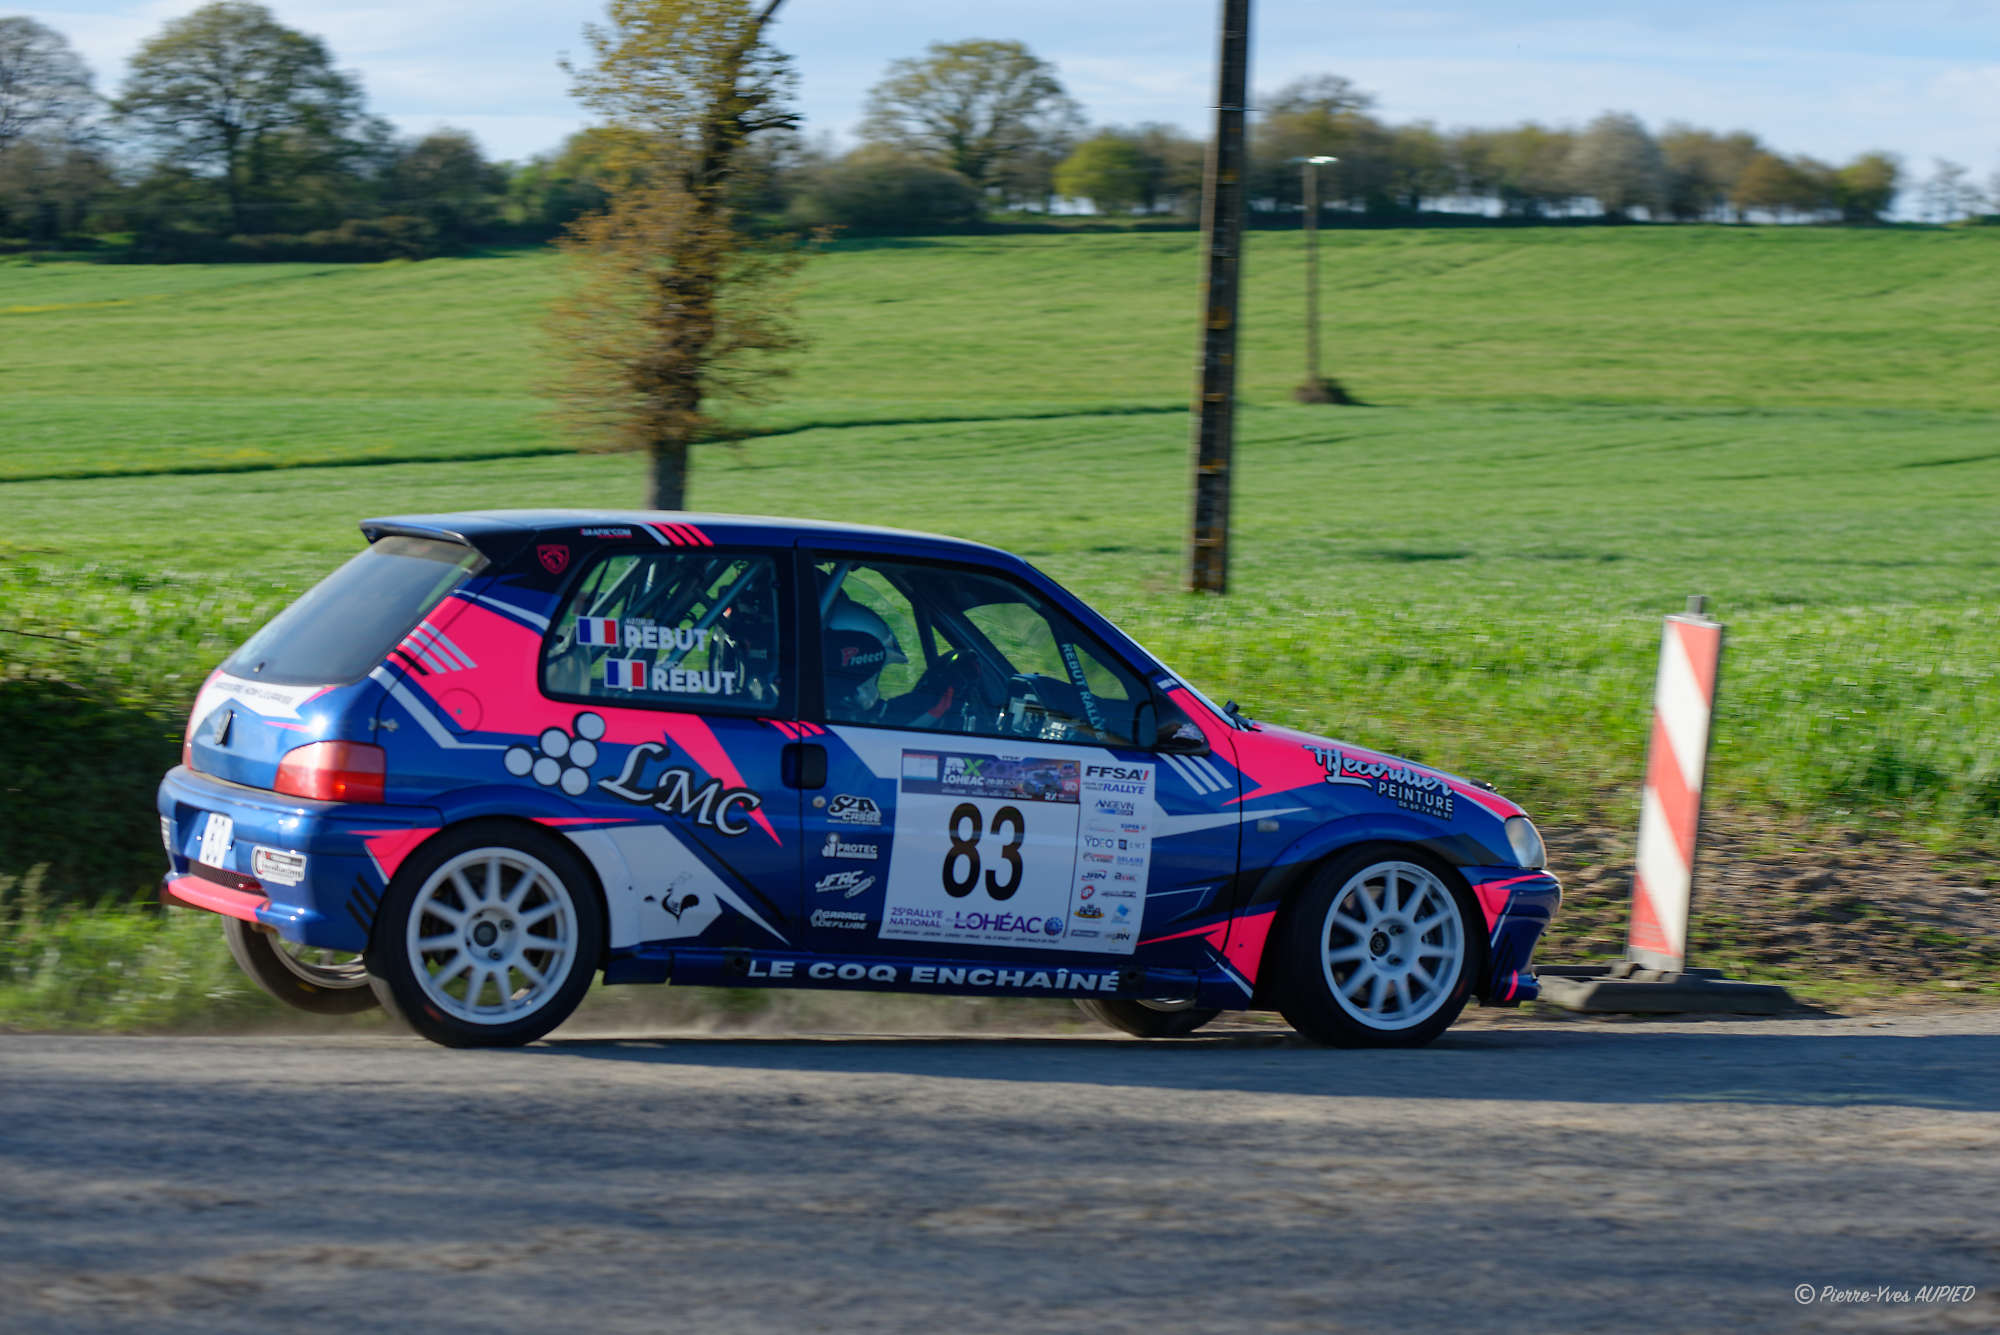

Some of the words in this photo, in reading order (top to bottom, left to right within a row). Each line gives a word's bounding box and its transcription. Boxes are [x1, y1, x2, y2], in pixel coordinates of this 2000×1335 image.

[624, 625, 709, 651] REBUT
[1062, 643, 1087, 686] REBUT
[652, 668, 736, 695] REBUT
[1086, 765, 1141, 781] FFSA
[597, 742, 761, 835] LMC
[1103, 783, 1146, 795] RALLYE
[1379, 781, 1453, 812] PEINTURE
[942, 802, 1025, 901] 83
[889, 917, 942, 928] NATIONAL
[906, 908, 944, 919] RALLYE
[954, 911, 1042, 934] LOHÉAC
[747, 960, 795, 978] LE
[808, 962, 898, 983] COQ
[910, 966, 1119, 991] ENCHAÎNÉ
